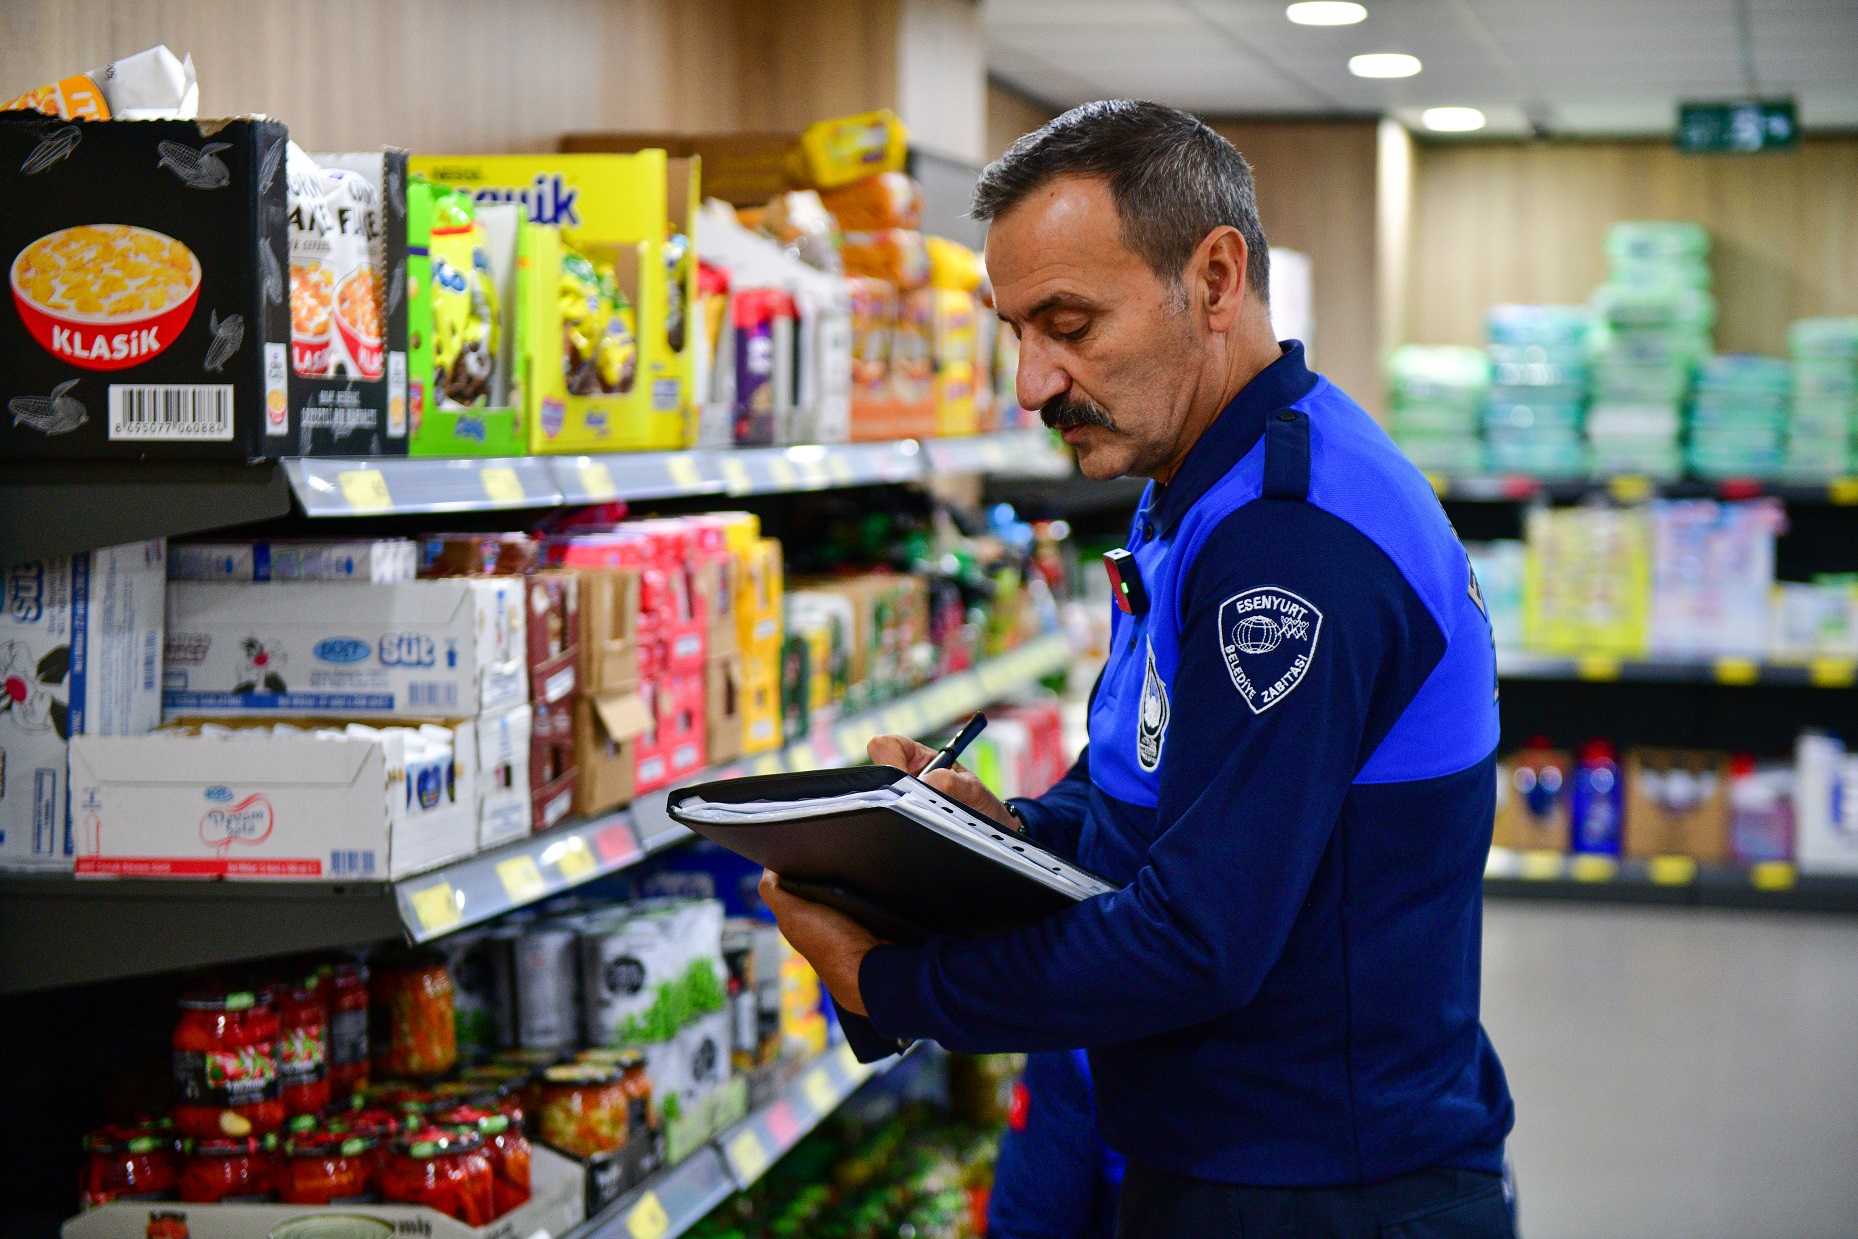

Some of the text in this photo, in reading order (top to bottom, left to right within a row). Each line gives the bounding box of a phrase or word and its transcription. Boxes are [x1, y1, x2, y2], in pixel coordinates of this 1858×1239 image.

[115, 423, 223, 433] 8 695077 060884
[1236, 595, 1309, 620] ESENYURT
[1224, 644, 1308, 703] BELEDİYE ZABITASI
